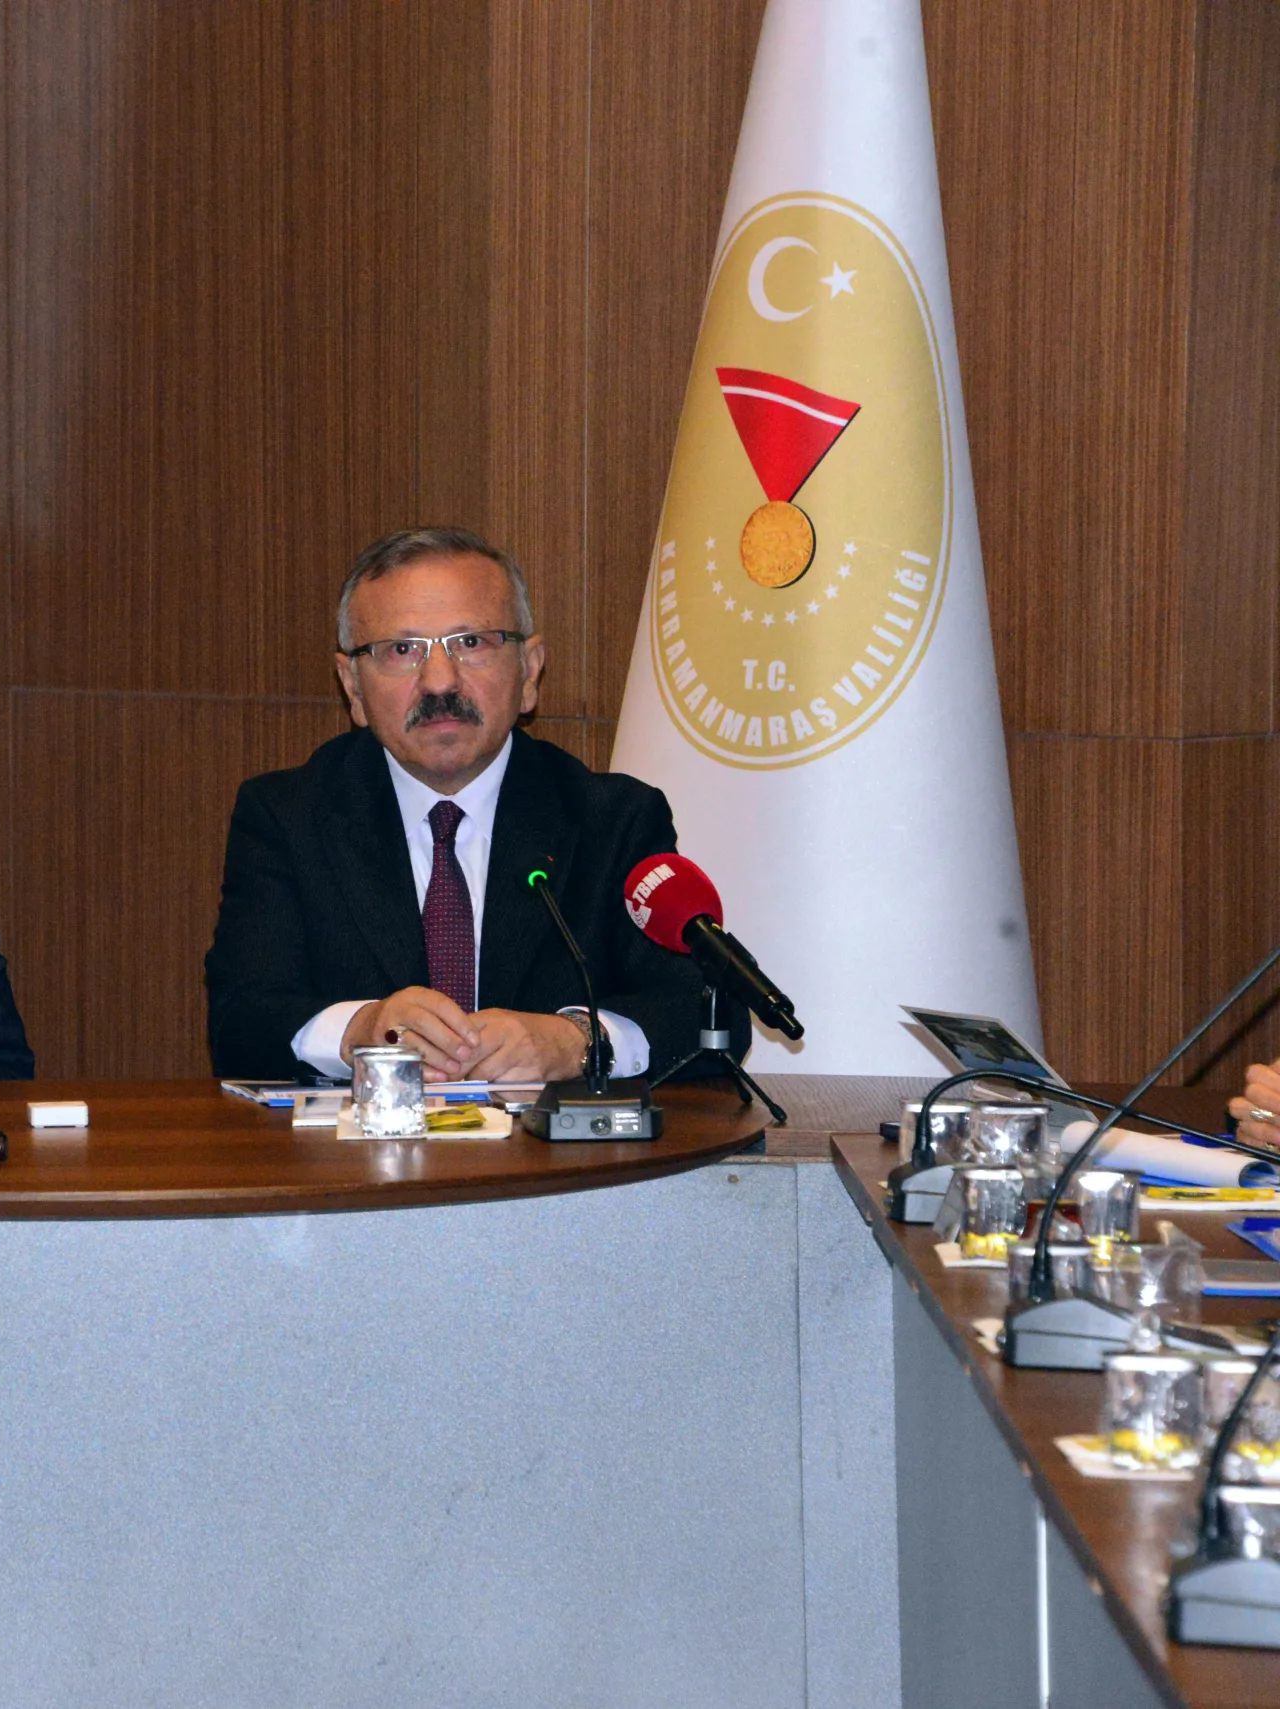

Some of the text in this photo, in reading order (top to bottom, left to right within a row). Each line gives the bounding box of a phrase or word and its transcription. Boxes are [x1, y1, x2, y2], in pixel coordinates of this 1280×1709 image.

[660, 541, 932, 747] KAHRAMANMARAŞ VALİLİĞİ
[743, 659, 796, 692] T.C.
[632, 863, 677, 905] TBMM
